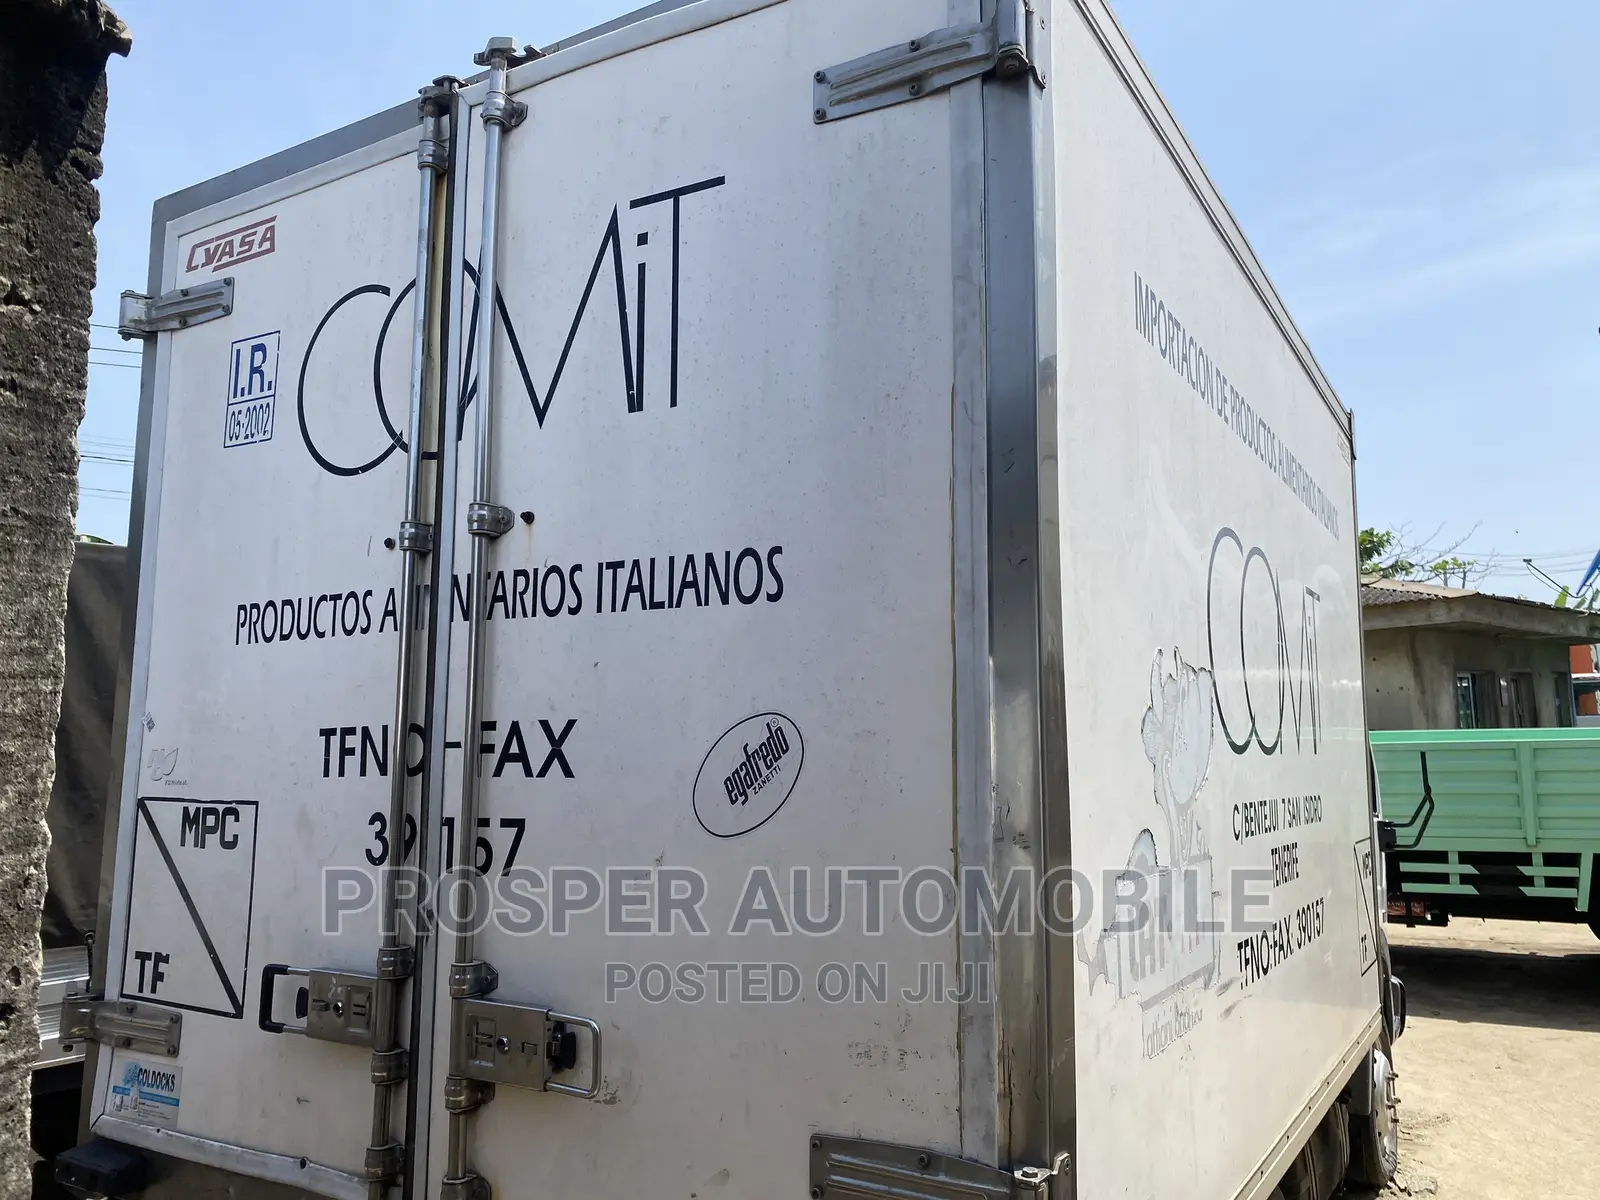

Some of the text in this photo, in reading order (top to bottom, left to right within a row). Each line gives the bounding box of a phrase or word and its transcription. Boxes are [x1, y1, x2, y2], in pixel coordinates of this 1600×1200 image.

[232, 342, 272, 399] I.R.
[1134, 270, 1213, 410] IMPORTACION
[1215, 366, 1229, 425] DE
[1230, 383, 1277, 474] PRODUCTOS
[235, 589, 373, 646] PRODUCTOS
[596, 545, 784, 614] ITALIANOS
[752, 764, 781, 796] ZANETTI
[180, 806, 240, 850] MPC
[1288, 796, 1300, 828] SAN
[1303, 795, 1323, 825] ISIDRO
[1271, 842, 1299, 888] TENERIFE
[1296, 897, 1325, 950] 390157
[135, 950, 170, 994] TF
[137, 1067, 176, 1093] COLDOCKS
